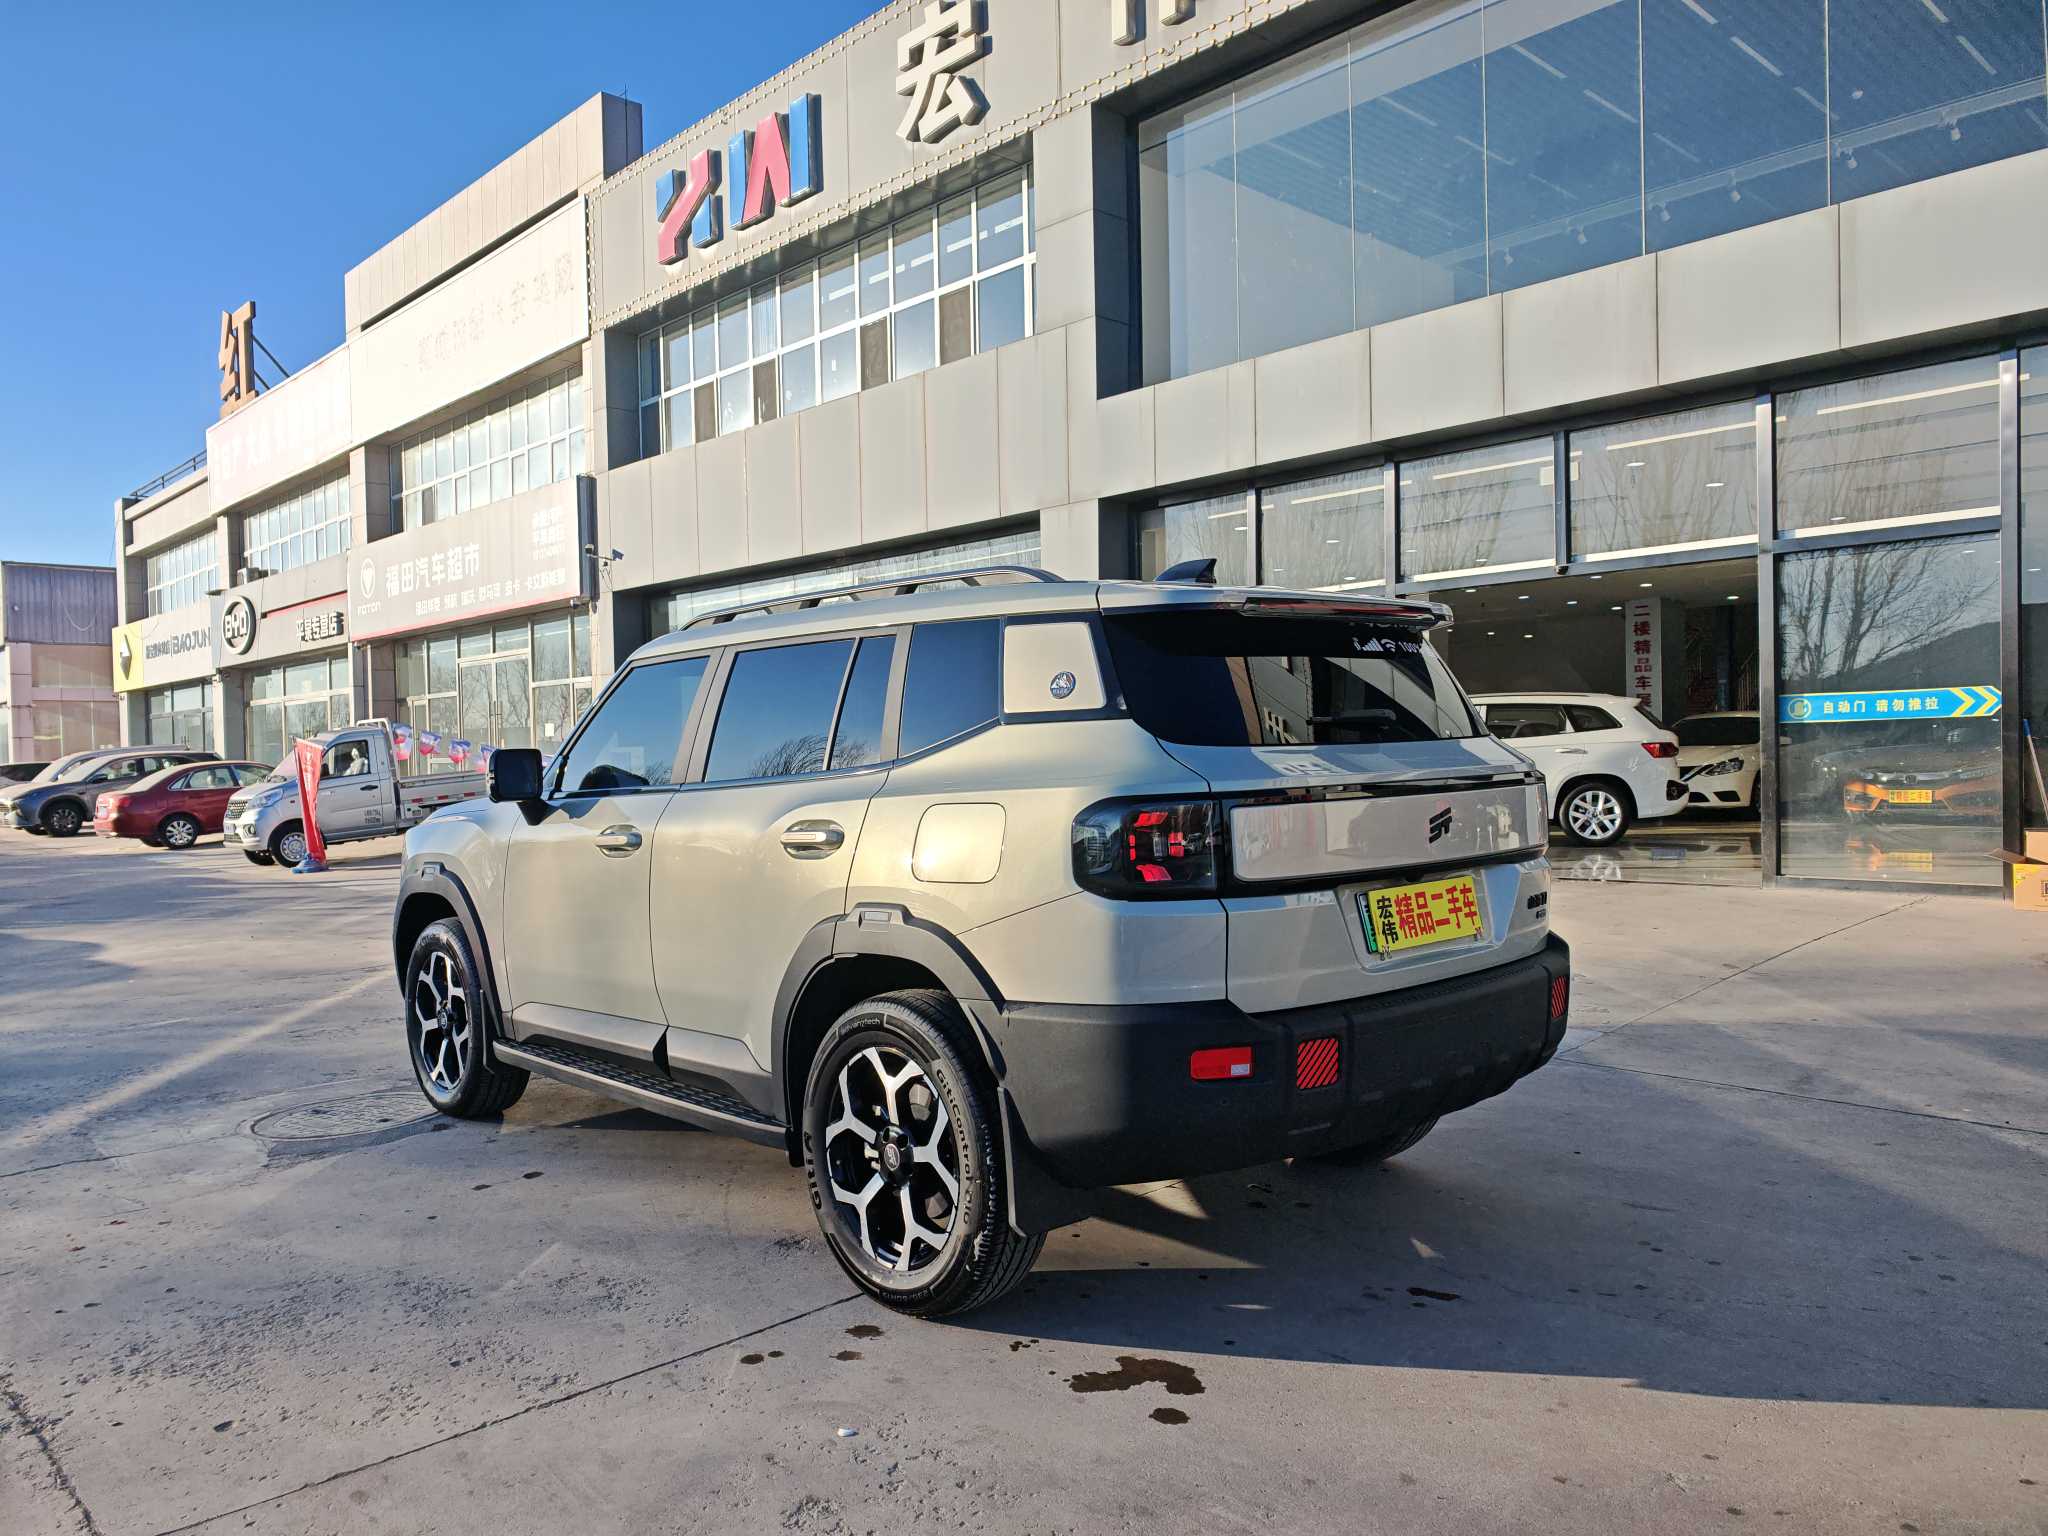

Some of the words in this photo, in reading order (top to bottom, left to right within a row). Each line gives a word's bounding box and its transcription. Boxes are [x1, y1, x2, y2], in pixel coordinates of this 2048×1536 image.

[385, 542, 481, 598] 福田汽车超市
[172, 627, 212, 655] BAOJUN
[224, 612, 248, 641] BYD
[1823, 700, 1866, 714] 自动门
[1876, 697, 1939, 712] 请勿推拉
[1377, 896, 1399, 944] 宏伟
[1394, 883, 1478, 939] 精品二手车
